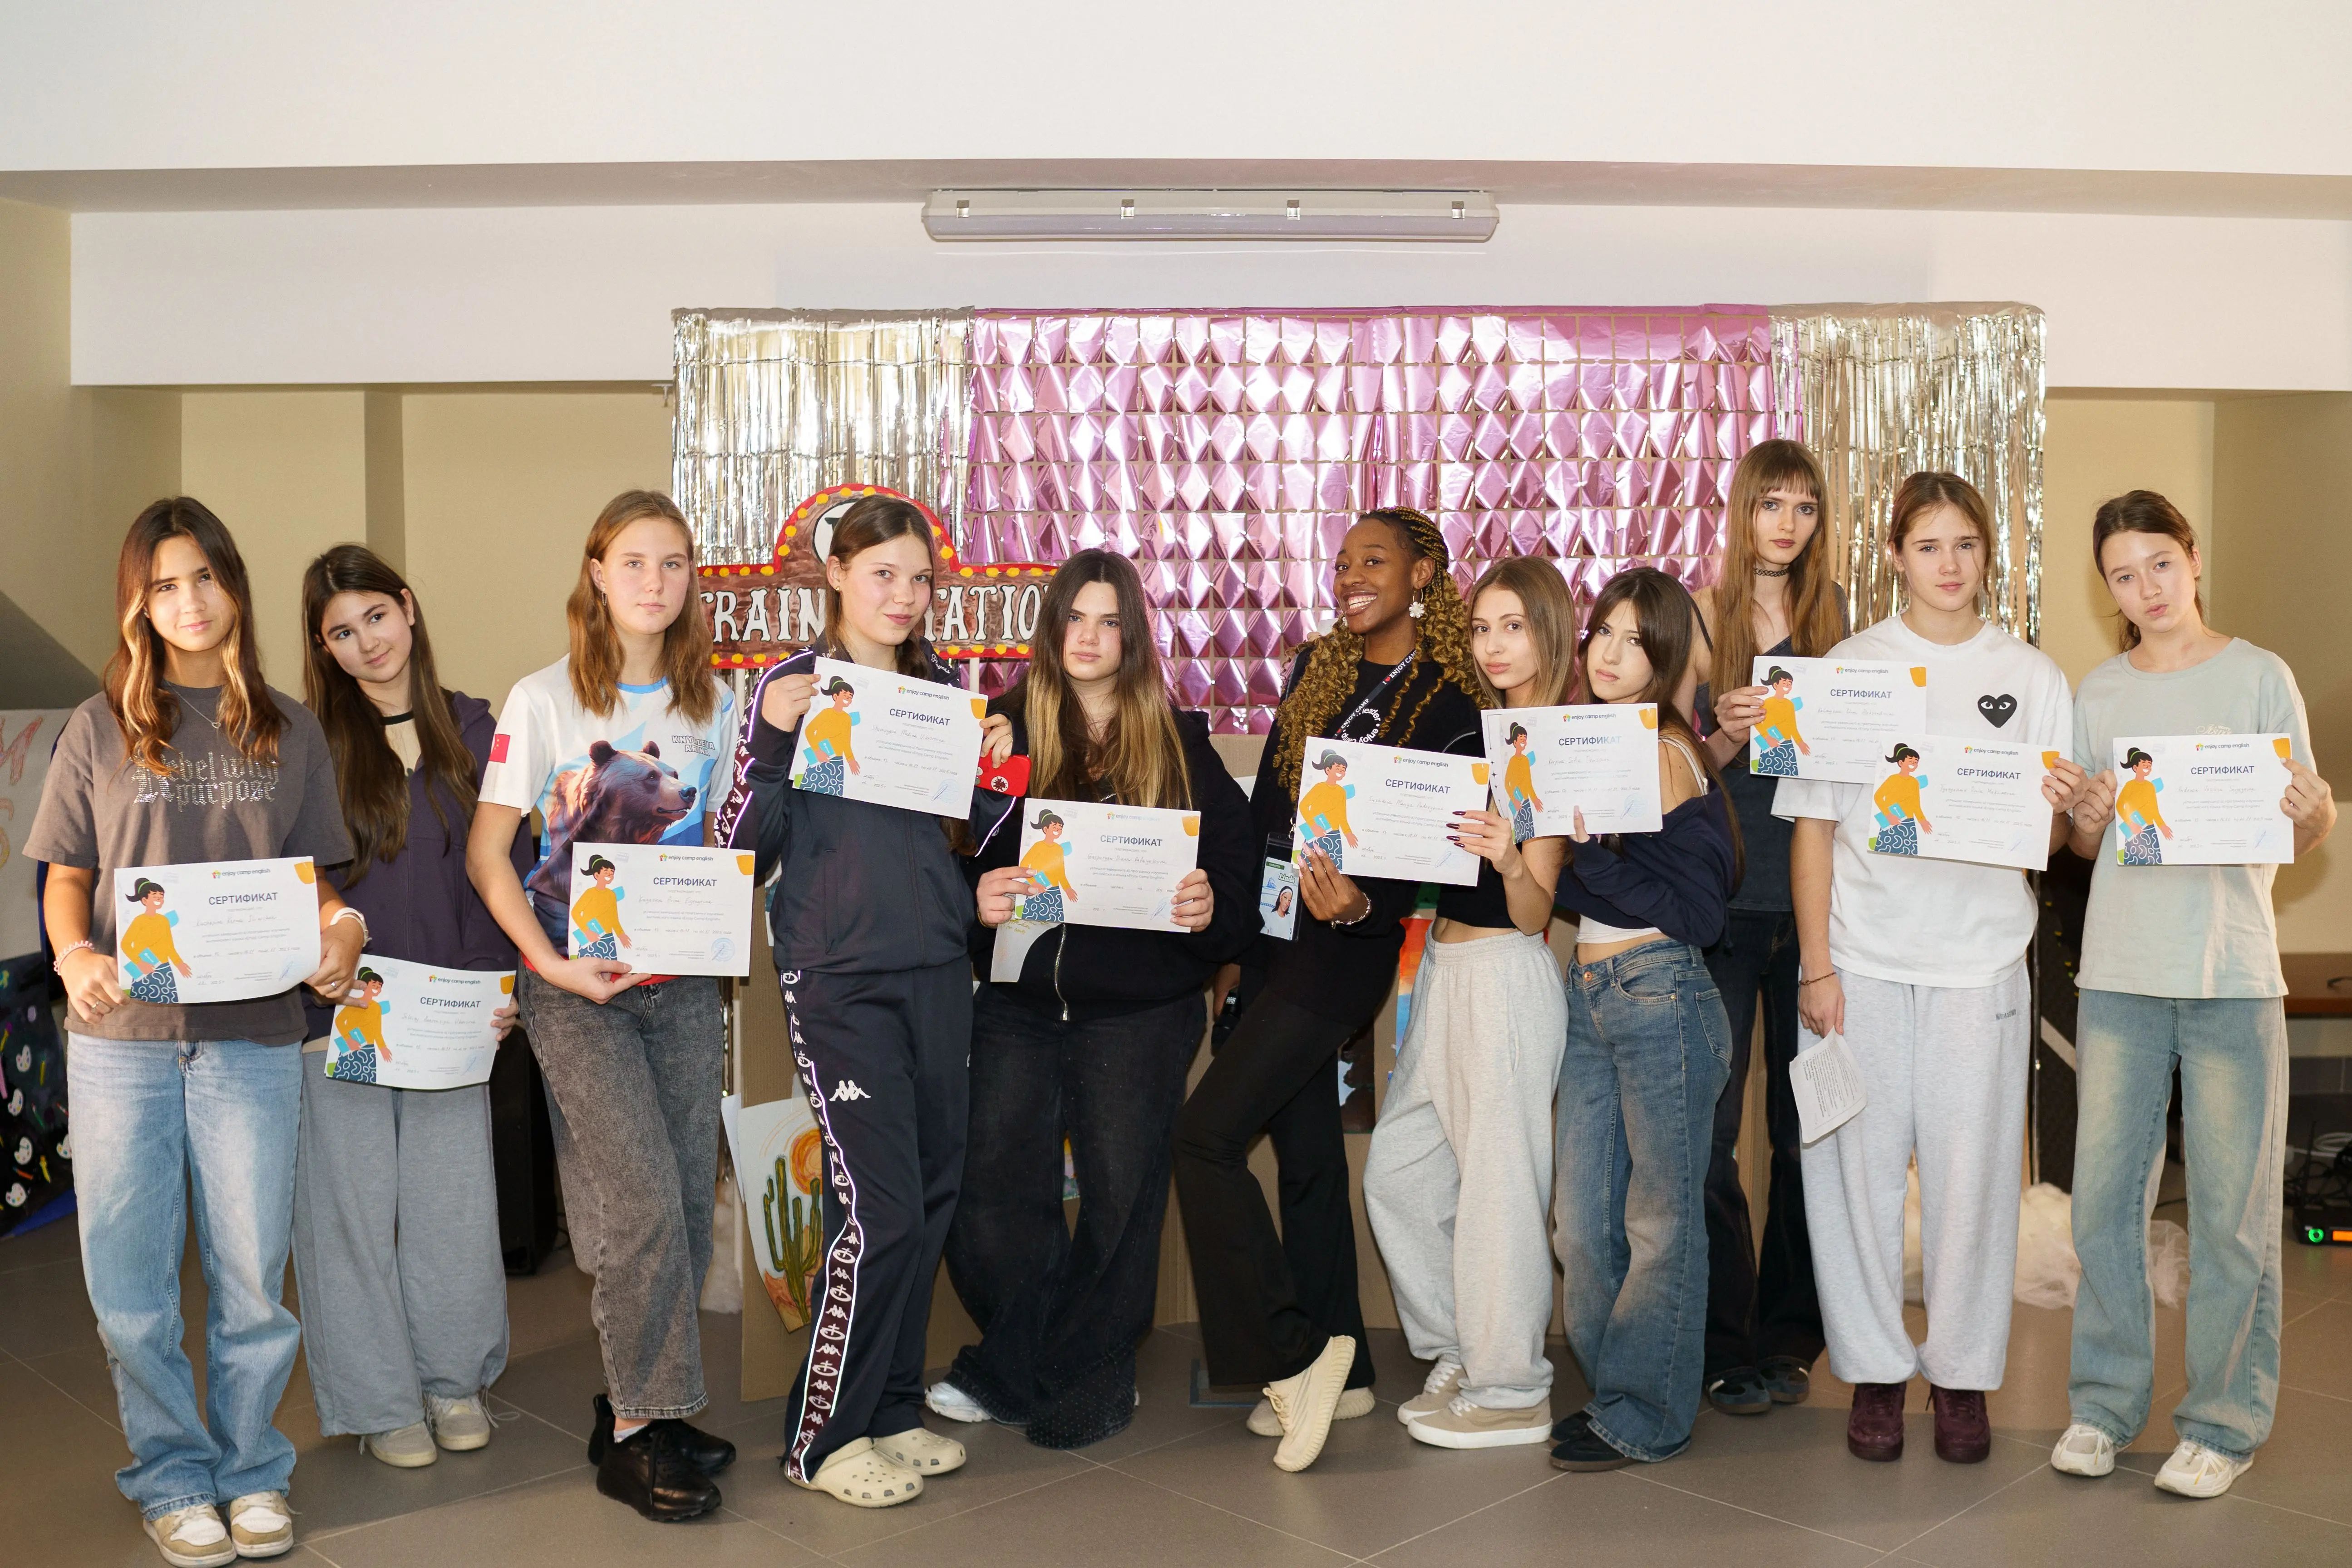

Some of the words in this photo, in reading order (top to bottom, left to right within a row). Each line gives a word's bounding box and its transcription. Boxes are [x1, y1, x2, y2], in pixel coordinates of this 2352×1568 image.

[700, 588, 827, 642] RAIN
[923, 584, 1049, 642] TATIO
[1389, 661, 1406, 678] ENJOY
[1830, 689, 1892, 698] СЕРТИФИКАТ
[890, 708, 951, 726] СЕРТИФИКАТ
[1341, 713, 1356, 729] ENJOY
[1355, 698, 1369, 713] CAMP
[1362, 708, 1381, 722] leader
[1359, 728, 1379, 743] enjoy
[1559, 736, 1622, 746] СЕРТИФИКАТ
[1958, 768, 2021, 779] СЕРТИФИКАТ
[2191, 766, 2254, 774] СЕРТИФИКАТ
[1386, 779, 1450, 794] СЕРТИФИКАТ
[176, 779, 276, 812] purpose
[1100, 835, 1163, 846] СЕРТИФИКАТ
[653, 877, 717, 886] СЕРТИФИКАТ
[1278, 873, 1295, 883] Linda
[209, 892, 278, 905] СЕРТИФИКАТ
[420, 997, 481, 1007] СЕРТИФИКАТ
